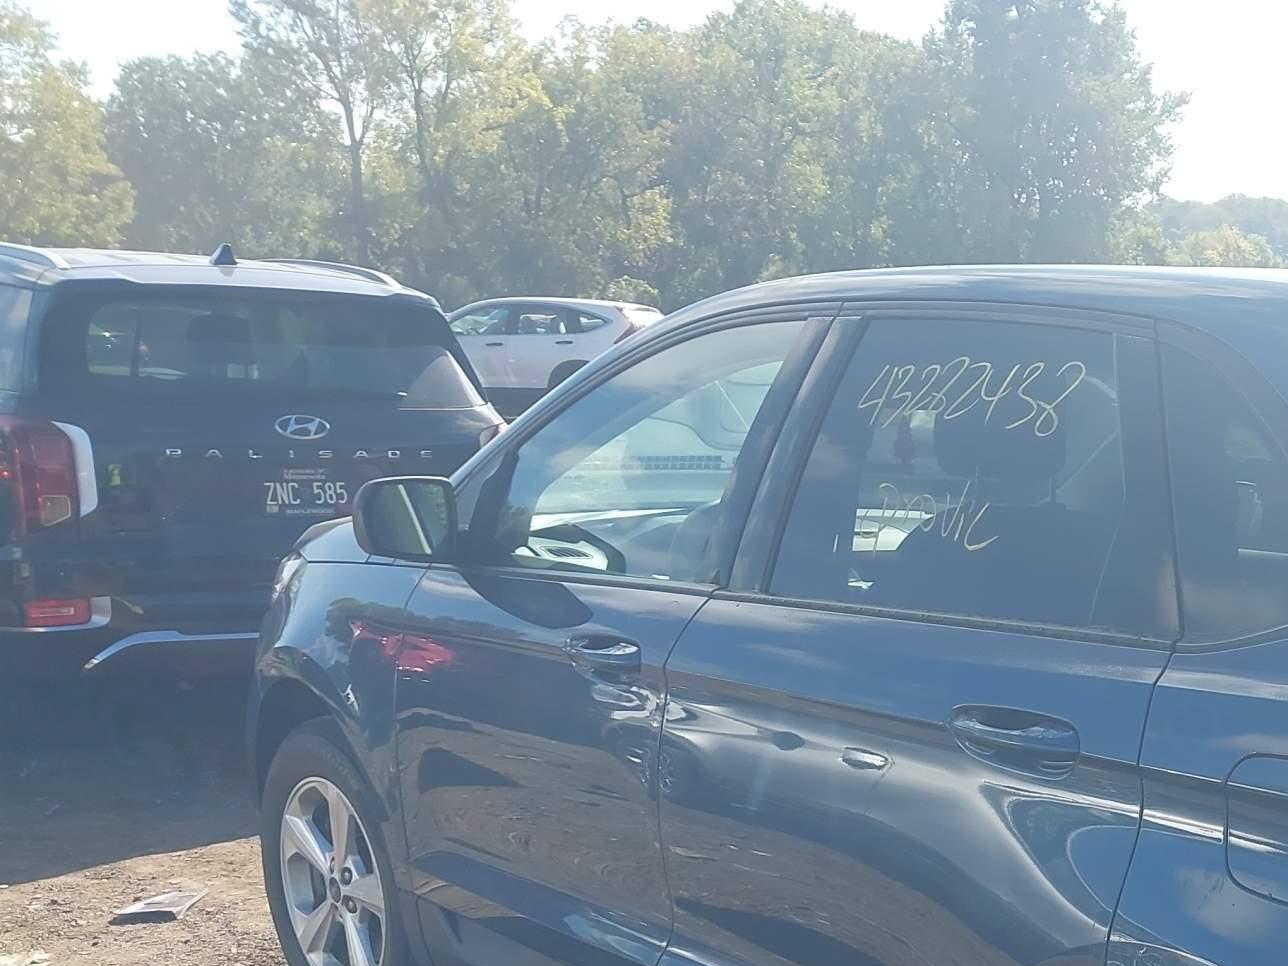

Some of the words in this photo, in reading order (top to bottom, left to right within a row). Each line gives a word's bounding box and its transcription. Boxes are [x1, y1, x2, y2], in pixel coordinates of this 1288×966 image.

[165, 448, 434, 459] PALISADE
[263, 481, 301, 505] ZNC
[312, 481, 348, 504] 585
